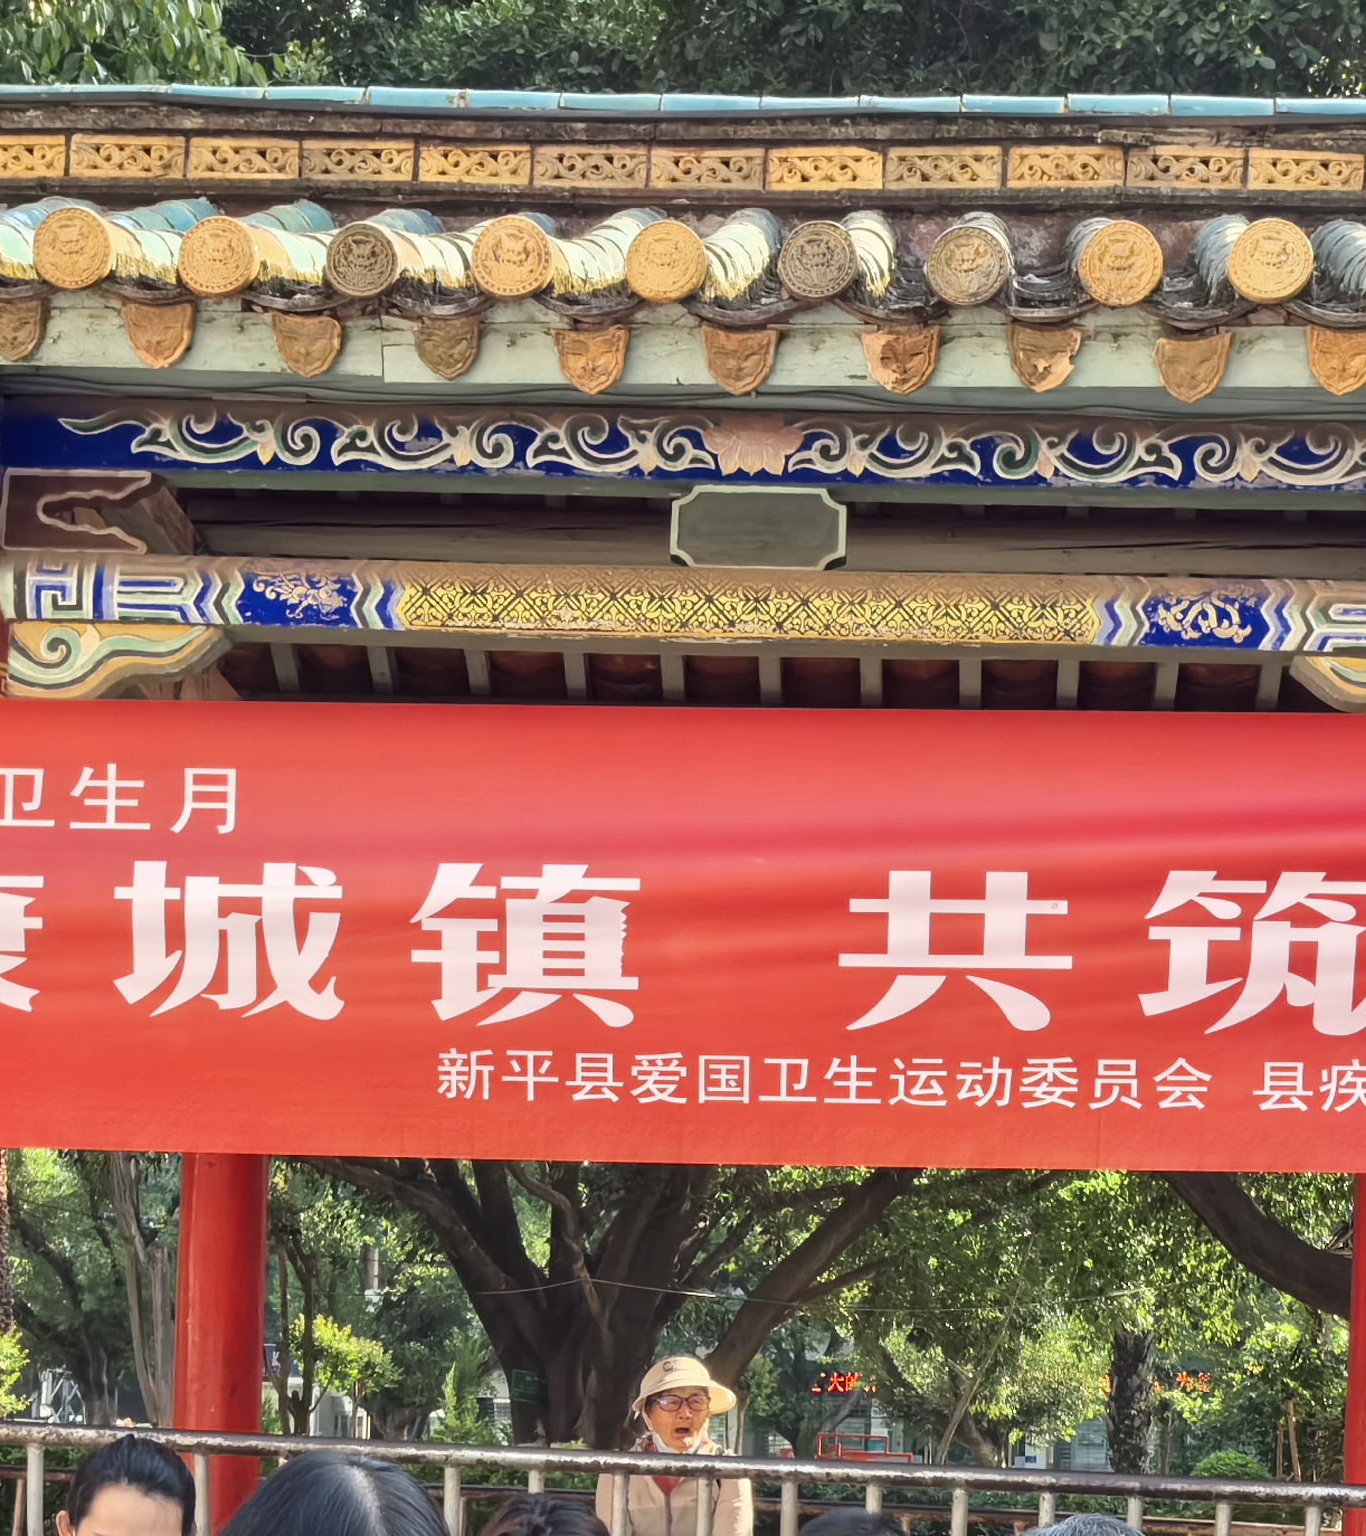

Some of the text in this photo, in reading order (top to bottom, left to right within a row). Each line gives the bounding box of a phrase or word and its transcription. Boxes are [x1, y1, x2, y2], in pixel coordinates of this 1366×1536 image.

[437, 1046, 1214, 1112] 新平县爱国卫生运动委员会
